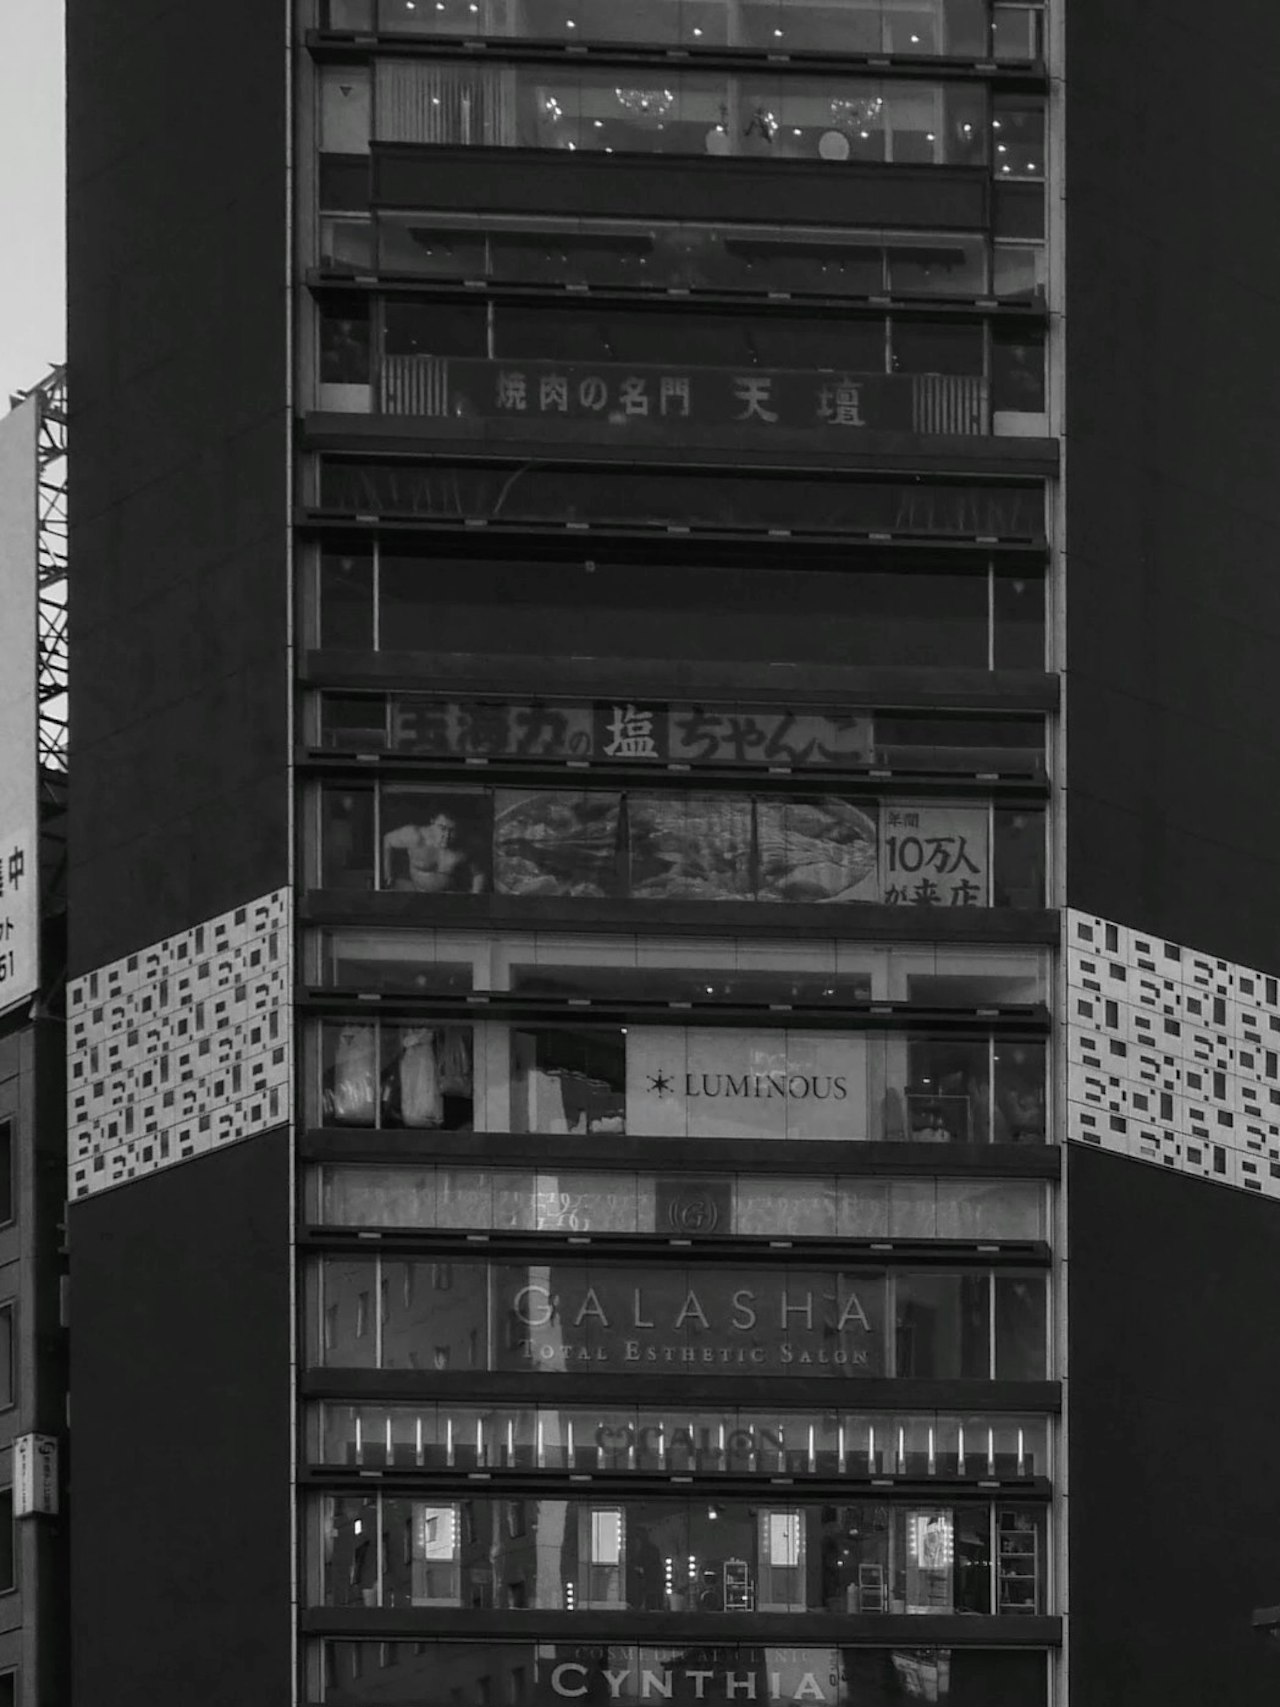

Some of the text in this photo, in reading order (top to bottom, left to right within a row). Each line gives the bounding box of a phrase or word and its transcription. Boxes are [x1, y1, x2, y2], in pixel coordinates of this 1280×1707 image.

[495, 371, 692, 417] 焼肉の名門
[885, 835, 982, 874] 10万人
[684, 1073, 847, 1100] LUMINOUS
[513, 1285, 871, 1332] GALASHA
[551, 1662, 827, 1701] CYNTHIA
